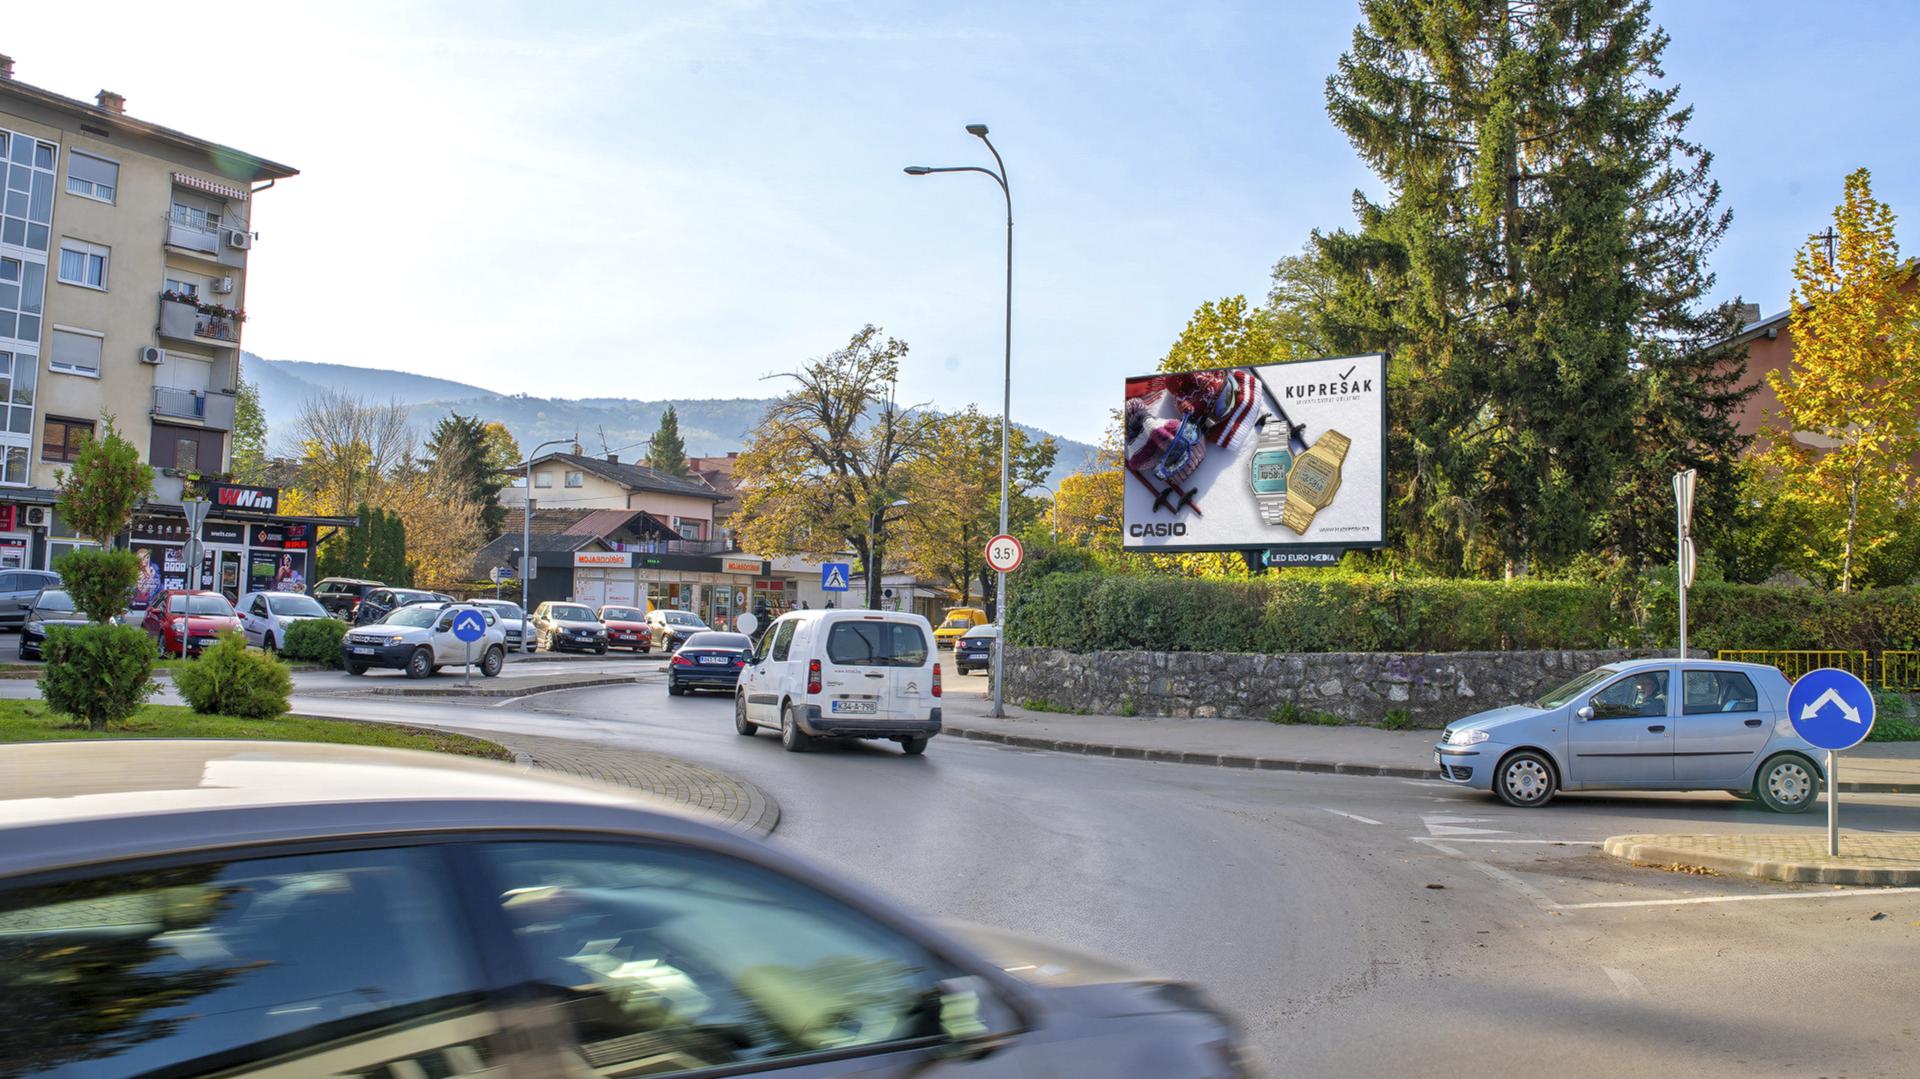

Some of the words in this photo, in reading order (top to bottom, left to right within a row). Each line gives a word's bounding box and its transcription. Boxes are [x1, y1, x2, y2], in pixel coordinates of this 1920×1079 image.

[218, 487, 273, 509] WWin
[1129, 522, 1187, 538] CASIO
[1271, 553, 1287, 562] LED
[1288, 553, 1309, 562] EURO
[1310, 553, 1335, 562] MEDIA
